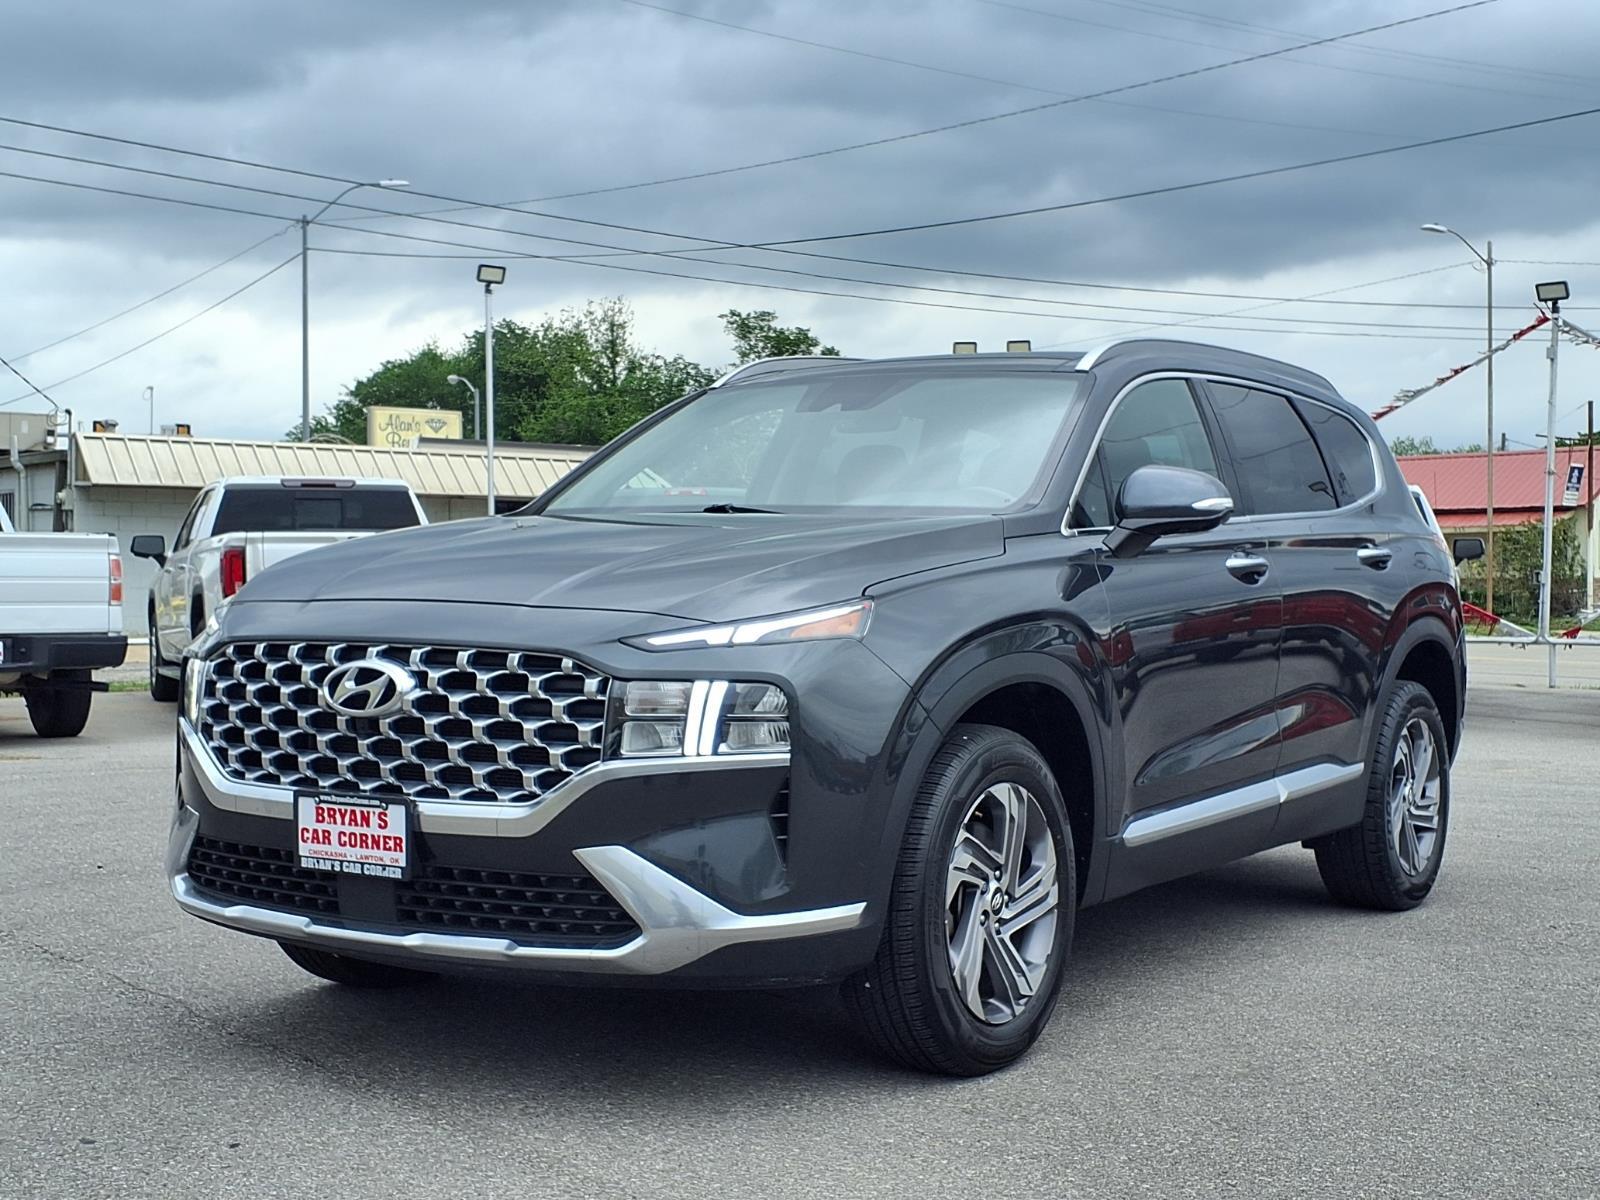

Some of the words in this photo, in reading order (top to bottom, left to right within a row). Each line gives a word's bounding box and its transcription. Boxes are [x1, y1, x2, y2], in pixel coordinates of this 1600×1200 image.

[378, 414, 421, 433] Alan's
[315, 806, 389, 830] BRYAN'S
[300, 827, 332, 846] CAR
[338, 830, 404, 853] CORNER
[308, 848, 348, 859] CHICKASHA
[389, 857, 400, 865] OK
[301, 857, 341, 871] BRYAN'S
[342, 861, 362, 874] CAR
[363, 864, 402, 879] CORNER
